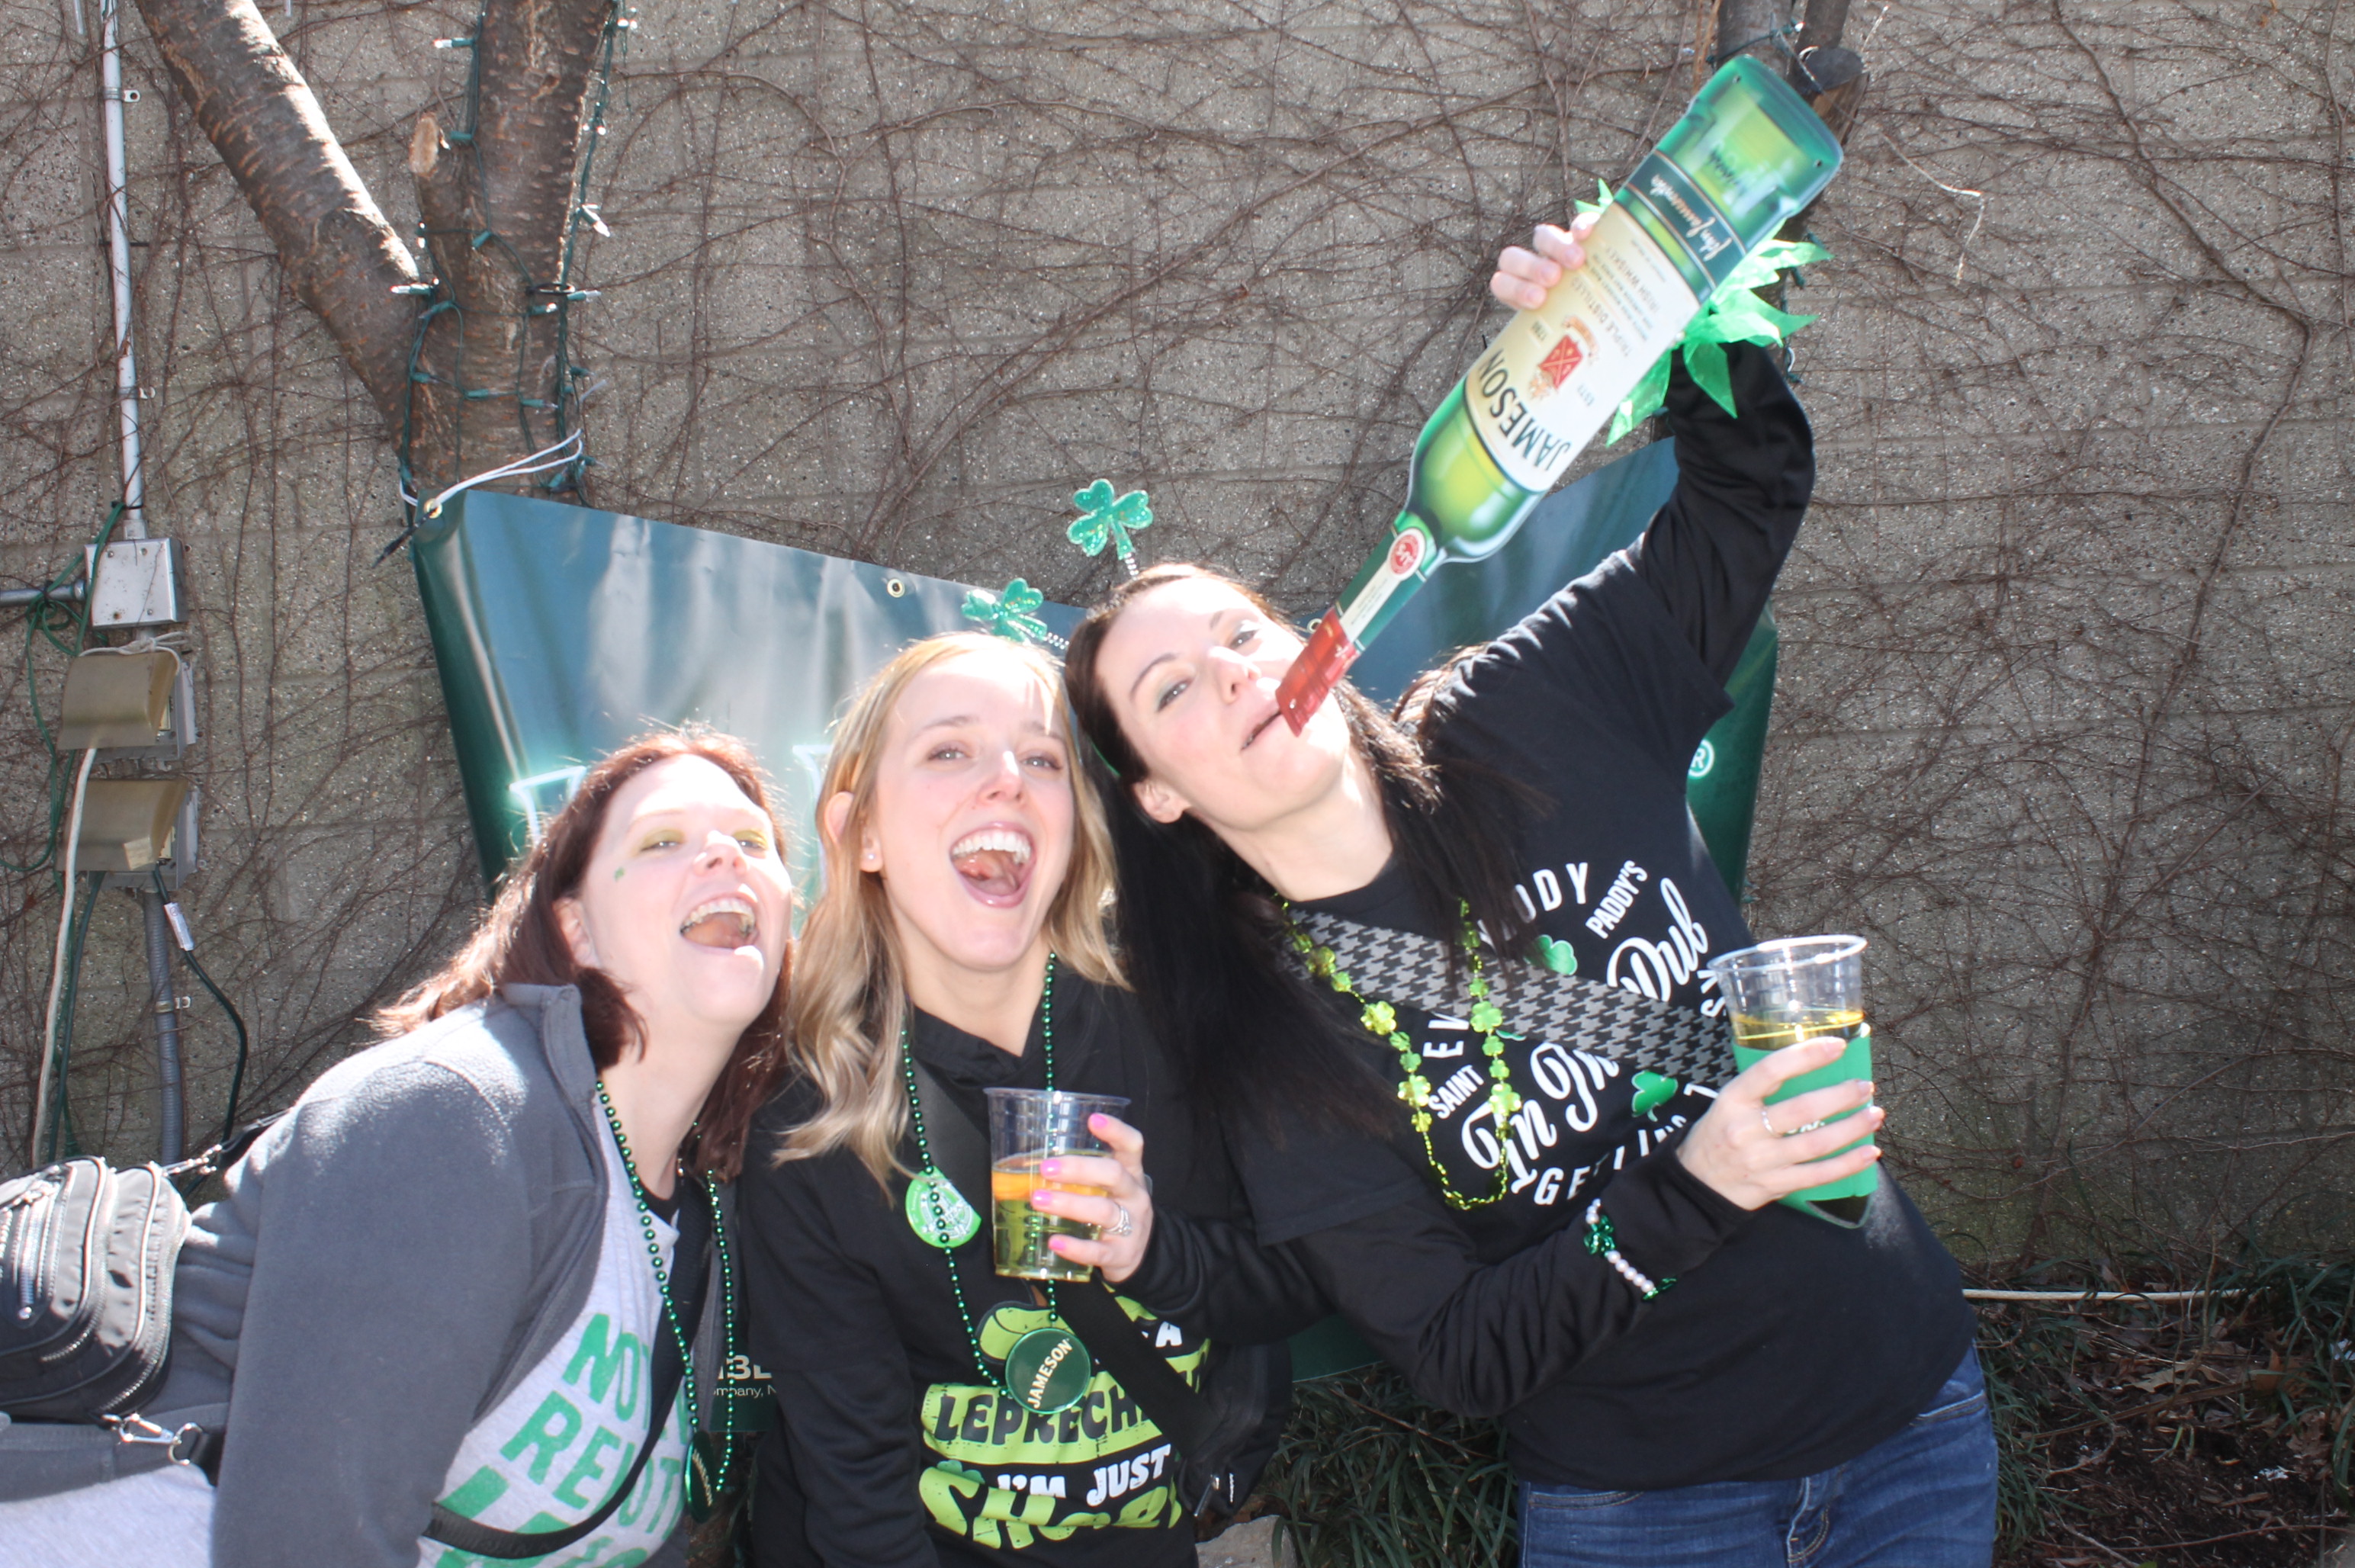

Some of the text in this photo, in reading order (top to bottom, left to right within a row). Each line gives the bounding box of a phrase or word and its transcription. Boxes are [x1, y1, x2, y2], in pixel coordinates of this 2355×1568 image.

[1567, 275, 1610, 323] DISTILLED
[1603, 321, 1636, 357] TRIPLE
[1479, 349, 1572, 471] JAMESON
[1586, 860, 1648, 938] PADDY'S
[1428, 1065, 1484, 1120] SAINT
[1027, 1338, 1073, 1409] JAMESON
[1086, 1444, 1171, 1506] JUST
